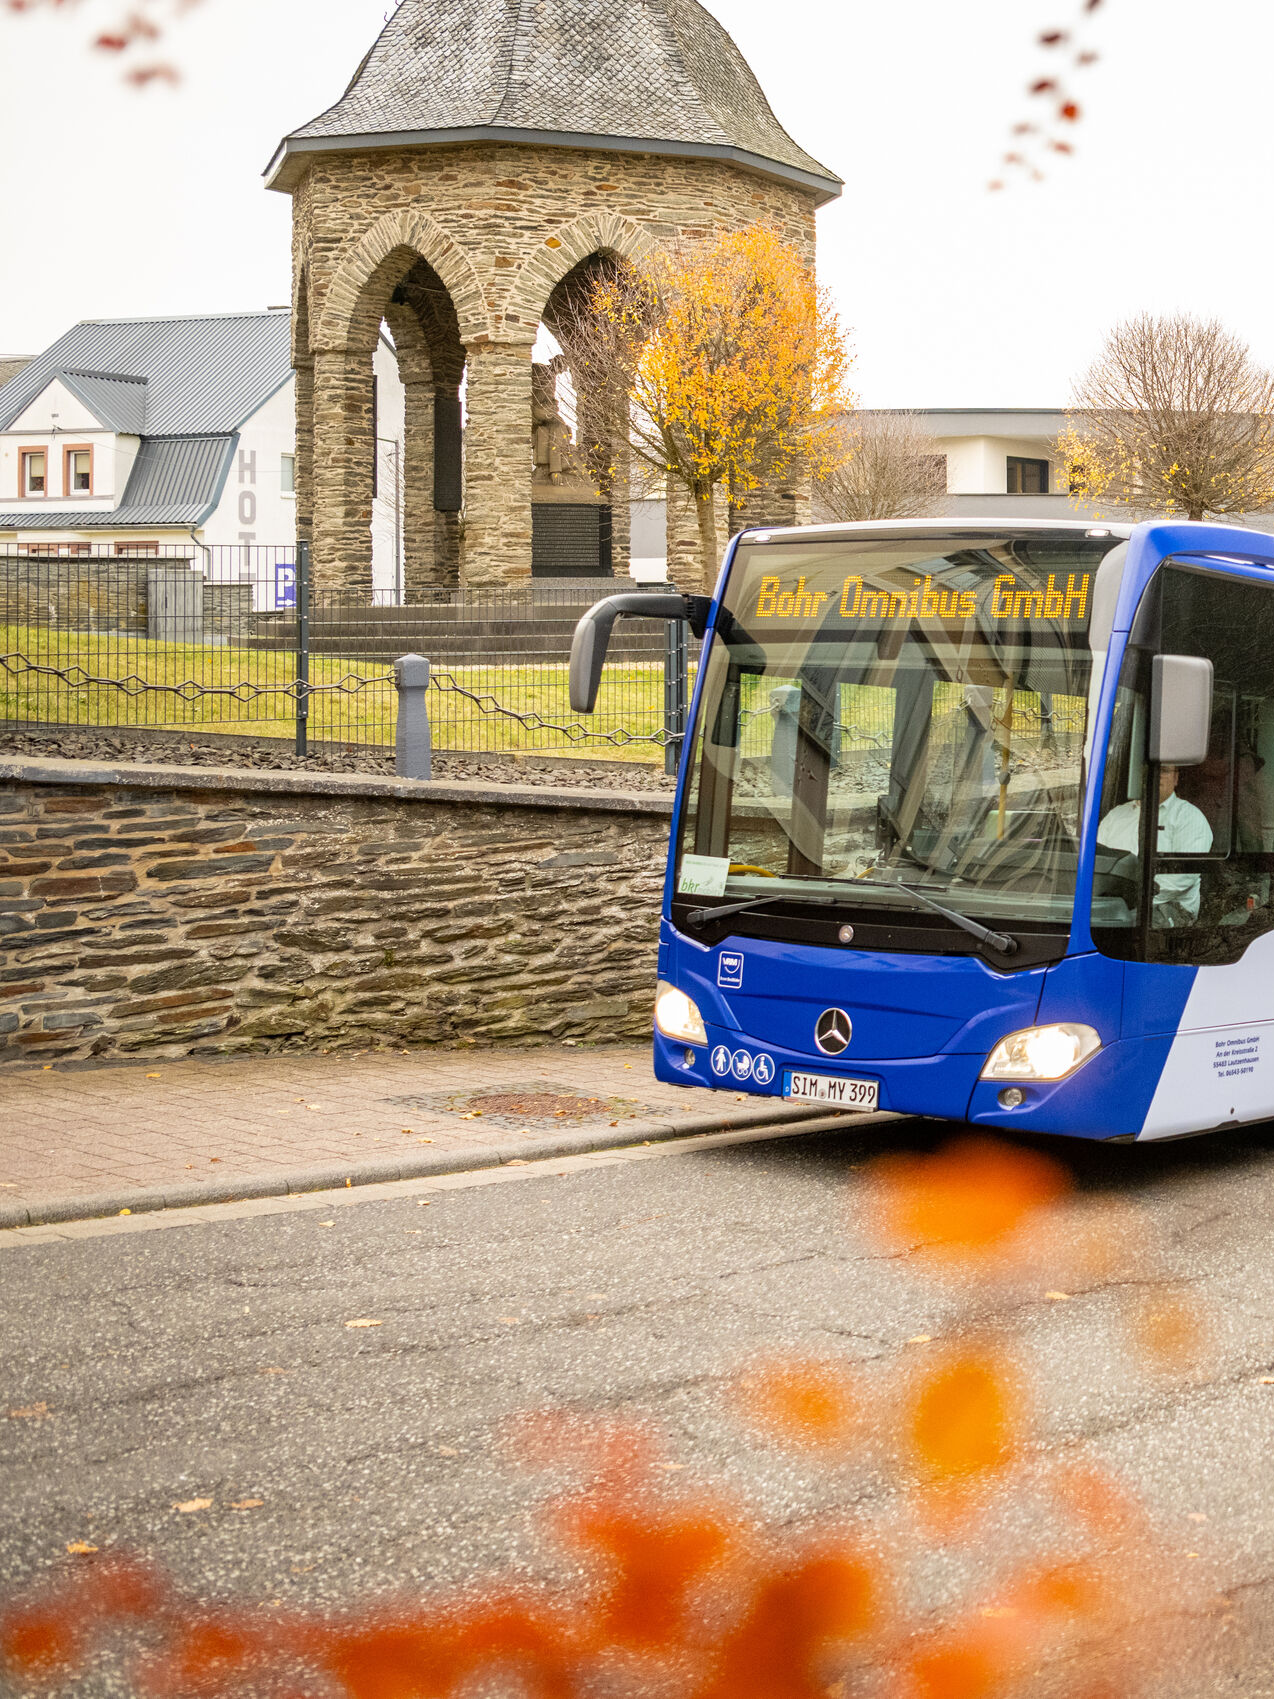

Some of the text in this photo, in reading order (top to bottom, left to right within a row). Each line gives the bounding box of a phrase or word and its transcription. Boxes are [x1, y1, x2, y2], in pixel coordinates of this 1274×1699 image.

[238, 449, 257, 584] HOT
[277, 567, 296, 598] P
[755, 573, 1090, 619] Bohr Omnibus GmbH
[1213, 1057, 1260, 1069] 55483 Lautzenhausen
[1223, 1049, 1231, 1057] der
[792, 1076, 818, 1097] SIM
[828, 1080, 846, 1100] MY
[849, 1083, 876, 1104] 399
